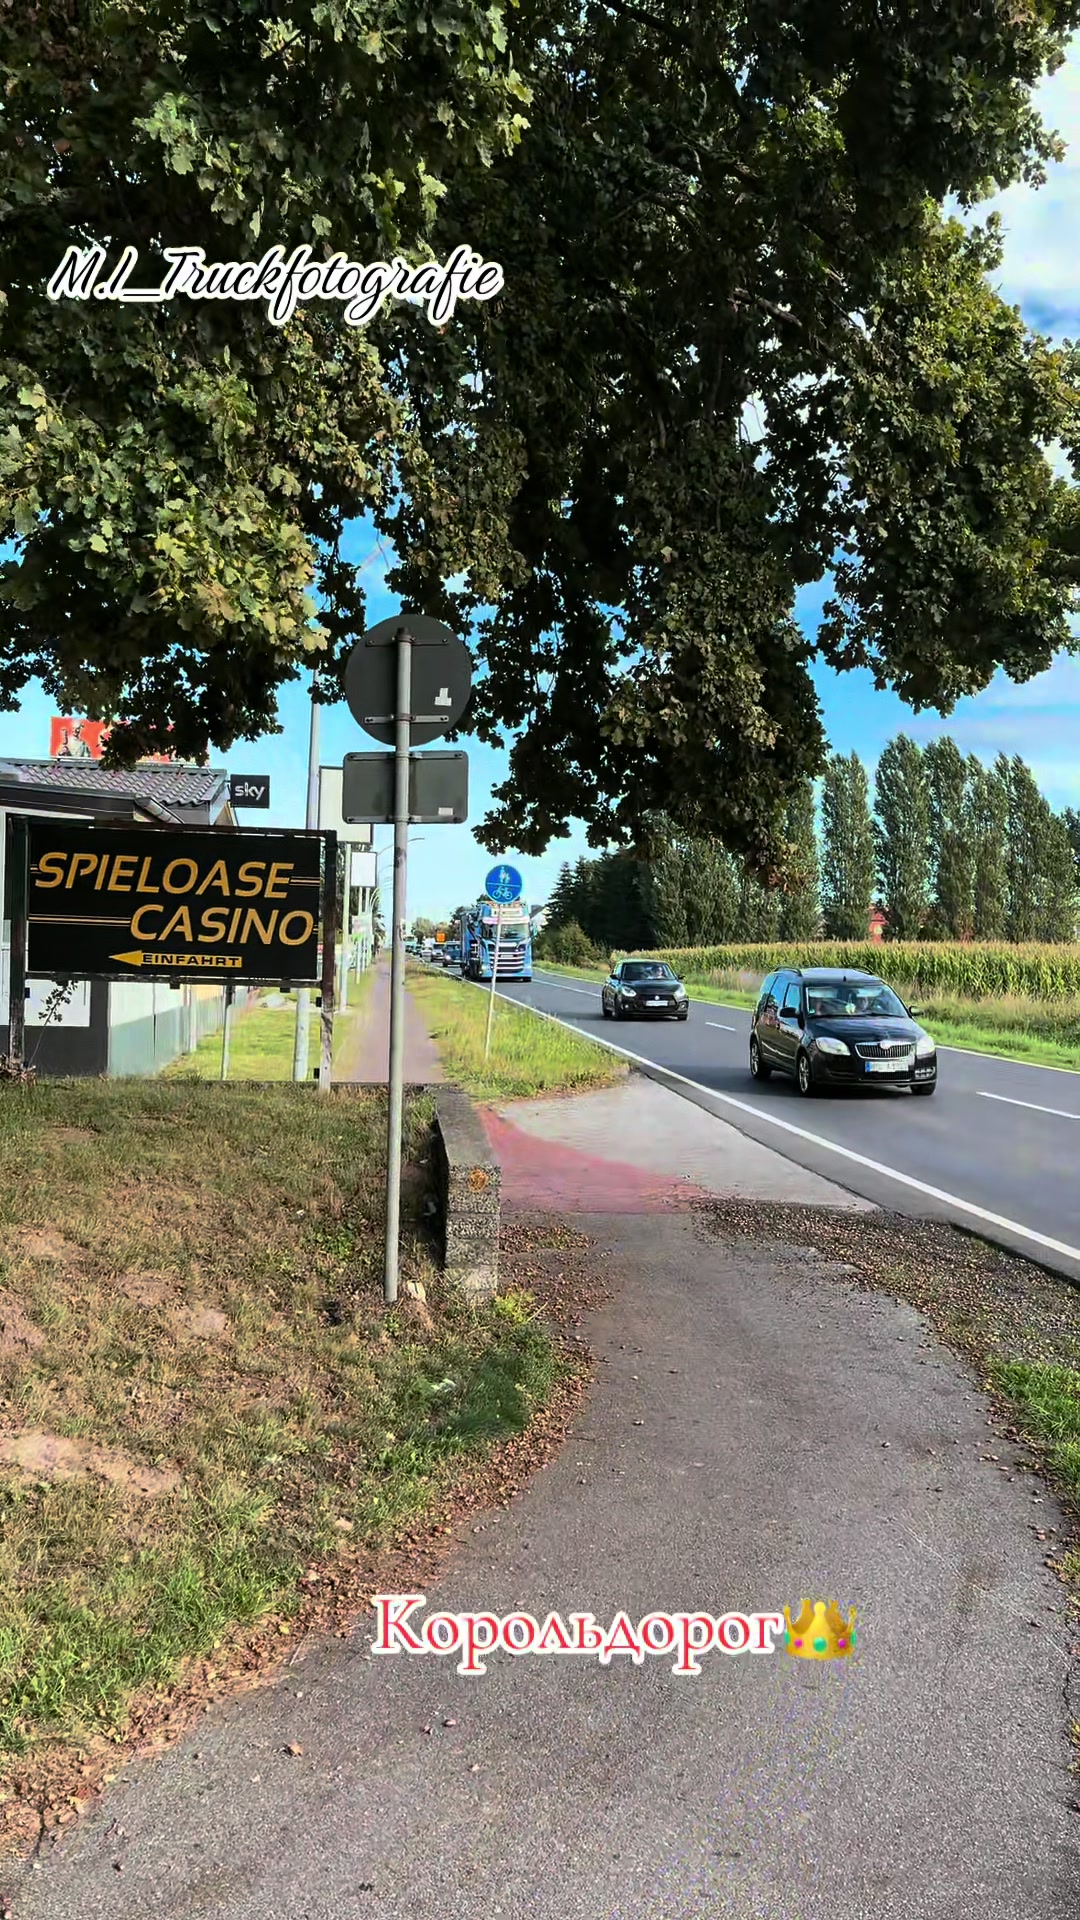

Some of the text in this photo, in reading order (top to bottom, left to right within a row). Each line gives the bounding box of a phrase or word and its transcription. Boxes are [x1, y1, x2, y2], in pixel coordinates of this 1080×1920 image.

[234, 781, 265, 801] sky
[35, 851, 295, 899] SPIELOASE
[129, 904, 314, 946] CASINO
[142, 953, 240, 967] EINFAHRT
